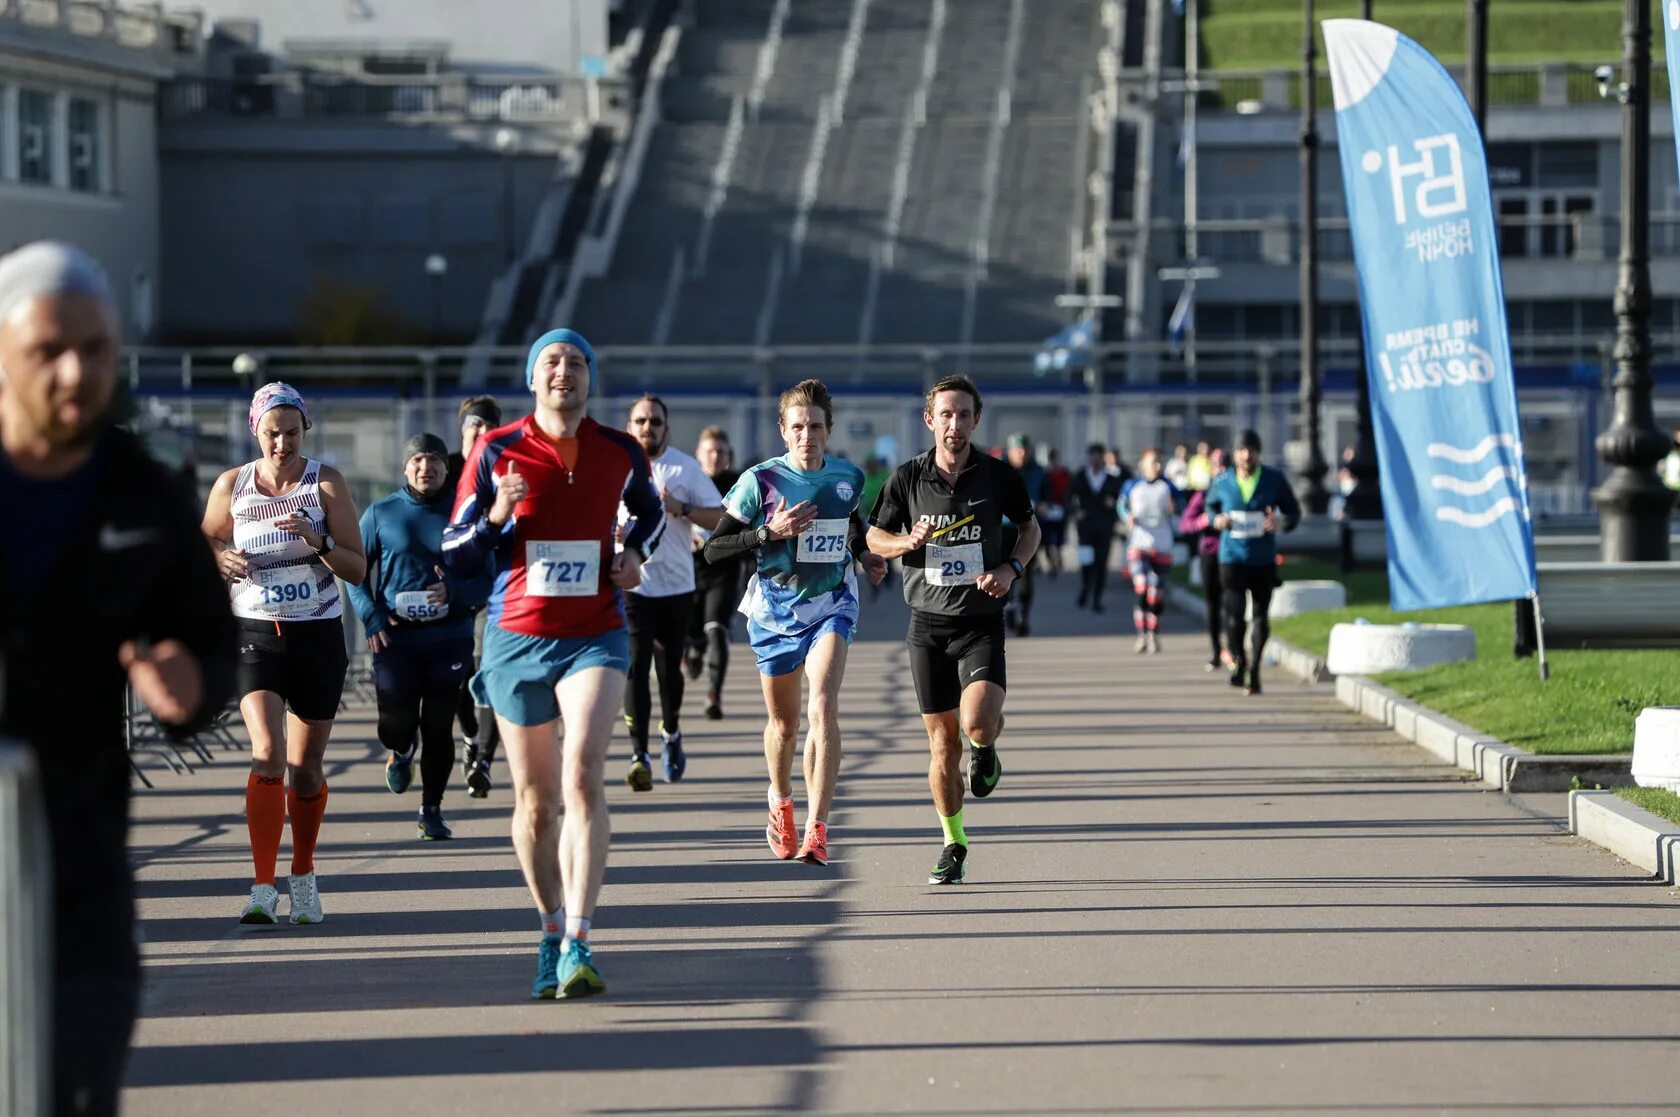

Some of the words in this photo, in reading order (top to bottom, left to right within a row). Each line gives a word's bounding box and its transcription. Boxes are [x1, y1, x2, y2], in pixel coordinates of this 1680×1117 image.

[947, 525, 982, 541] LAB
[805, 535, 845, 552] 1275
[542, 562, 586, 582] 727
[941, 560, 966, 577] 29
[260, 581, 311, 604] 1390
[407, 604, 438, 618] 559
